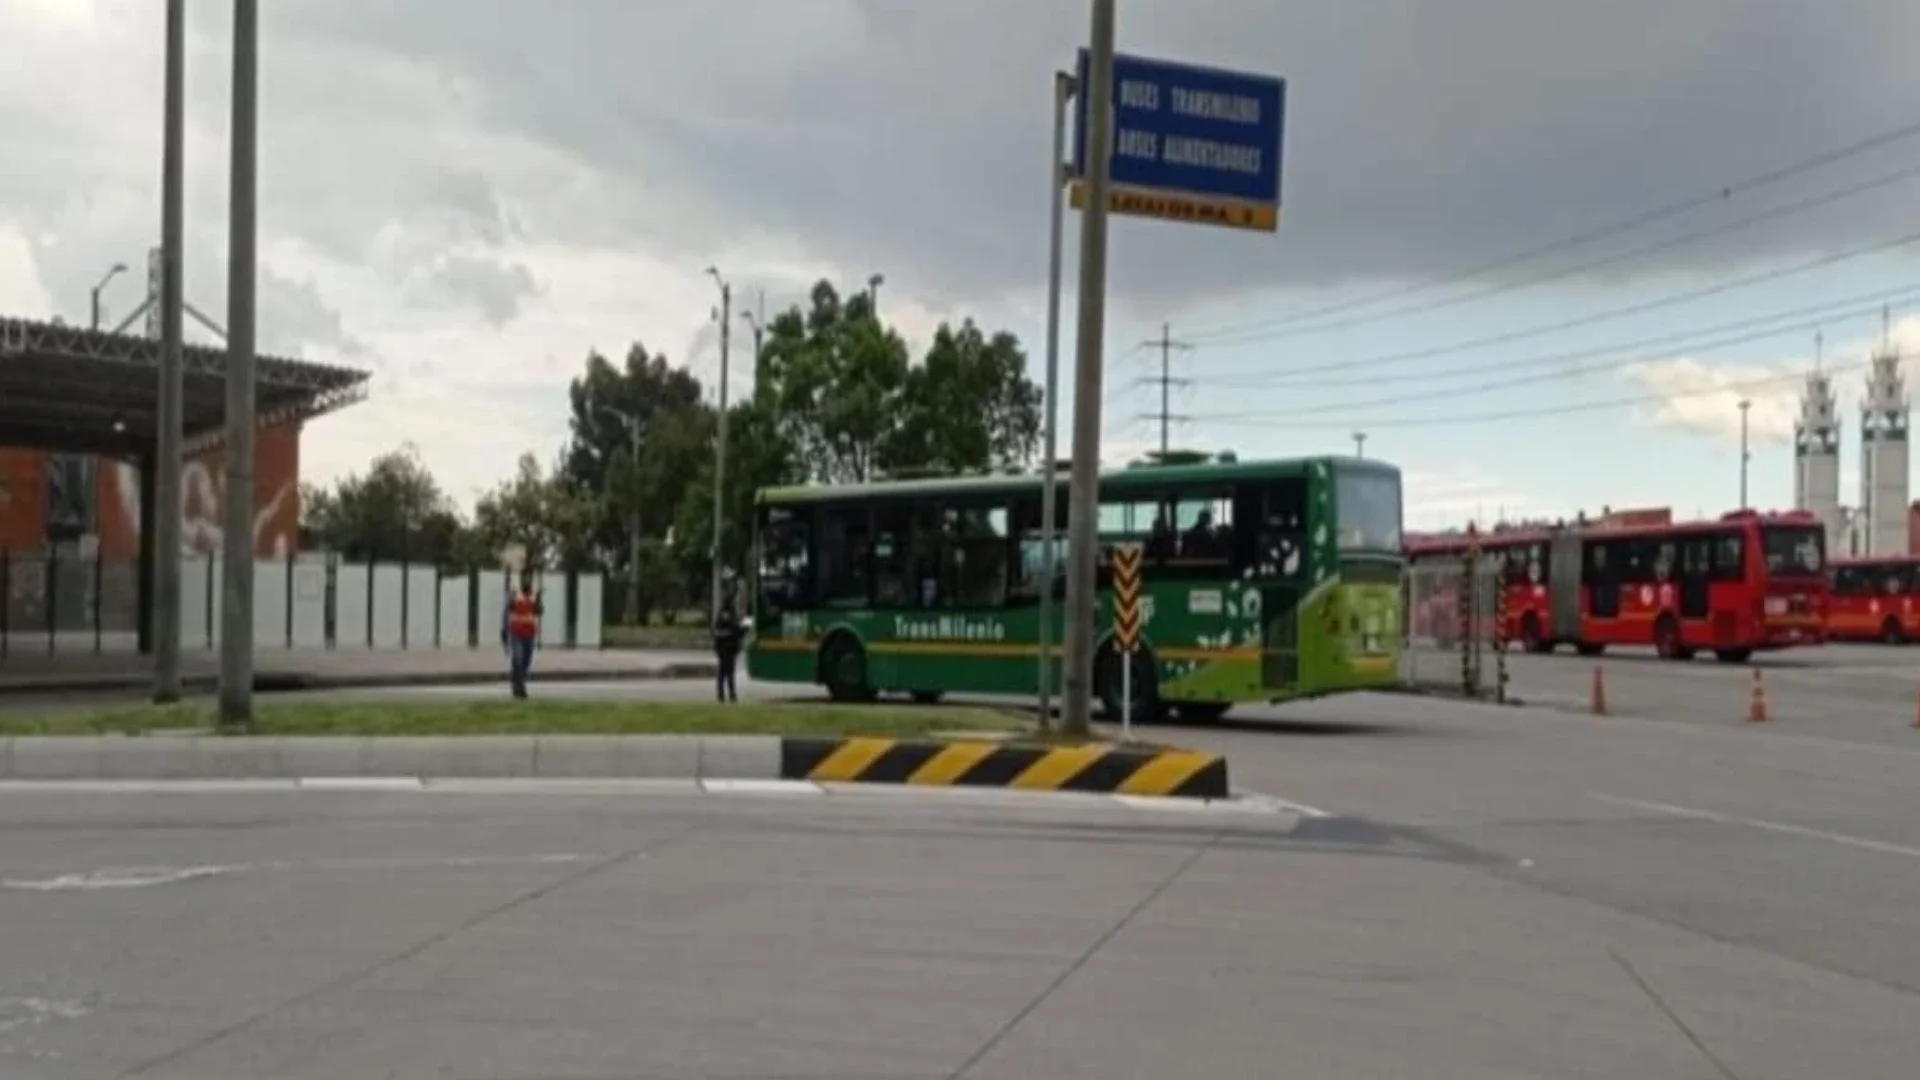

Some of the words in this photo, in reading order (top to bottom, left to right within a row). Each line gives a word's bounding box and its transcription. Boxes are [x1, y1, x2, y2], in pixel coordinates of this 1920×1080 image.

[1172, 87, 1260, 122] TRANSMILENIO
[1164, 136, 1261, 173] ALIMENTADORES
[894, 615, 1004, 640] TransMilenio
